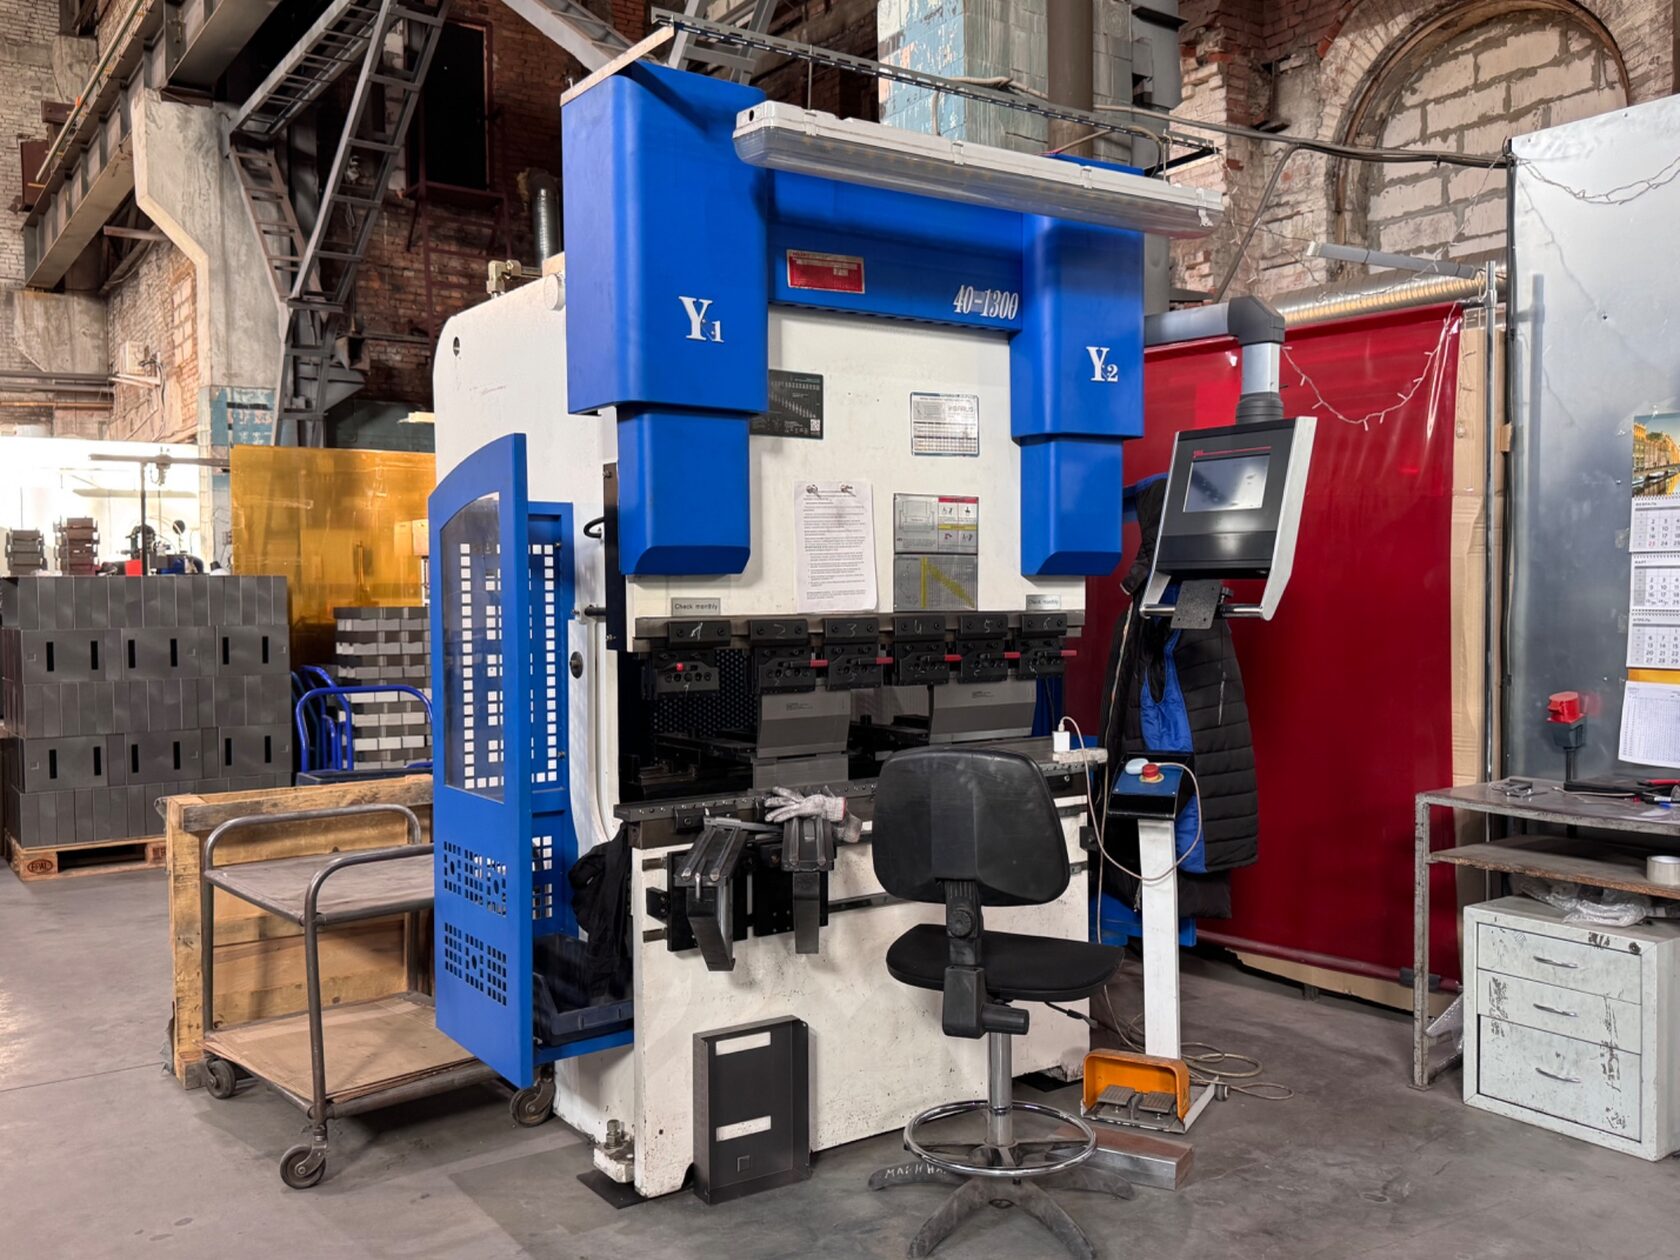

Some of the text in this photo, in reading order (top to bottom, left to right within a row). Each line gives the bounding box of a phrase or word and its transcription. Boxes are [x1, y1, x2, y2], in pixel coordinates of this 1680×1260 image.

[953, 284, 1019, 320] 40-1300
[773, 623, 786, 640] 2
[847, 623, 857, 638] 3
[983, 619, 991, 633] 5
